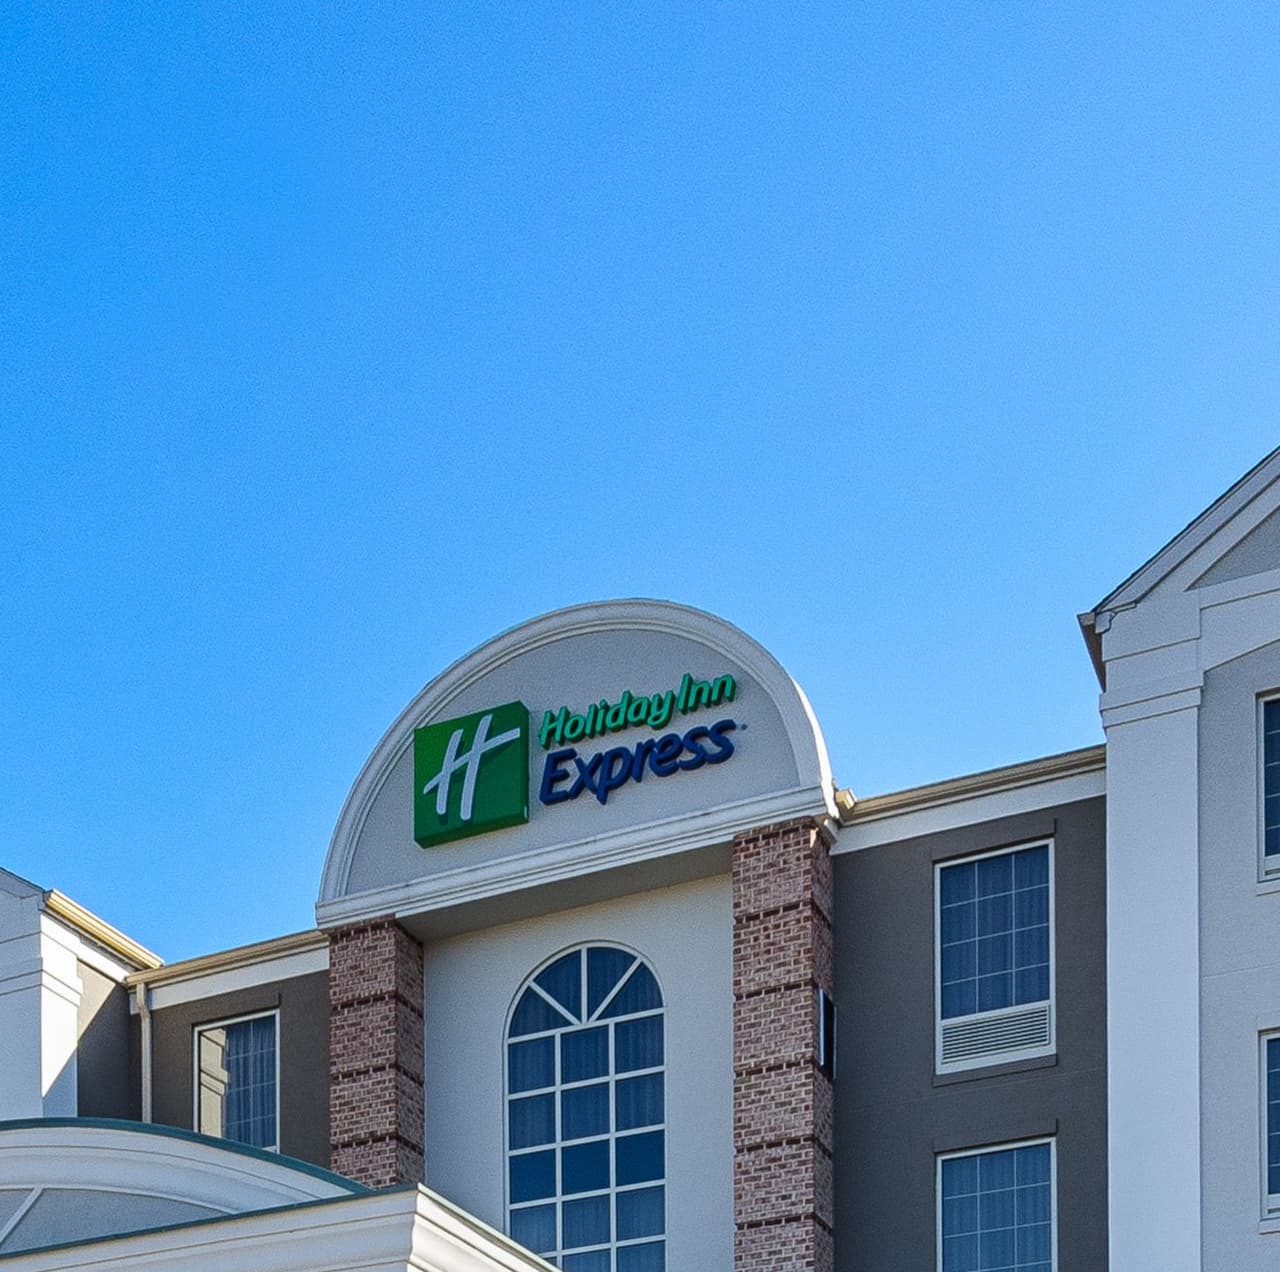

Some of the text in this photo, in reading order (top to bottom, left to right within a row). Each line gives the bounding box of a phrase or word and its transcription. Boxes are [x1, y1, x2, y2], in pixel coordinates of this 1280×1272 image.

[539, 673, 736, 749] Holiday Inn
[539, 719, 737, 806] Express
